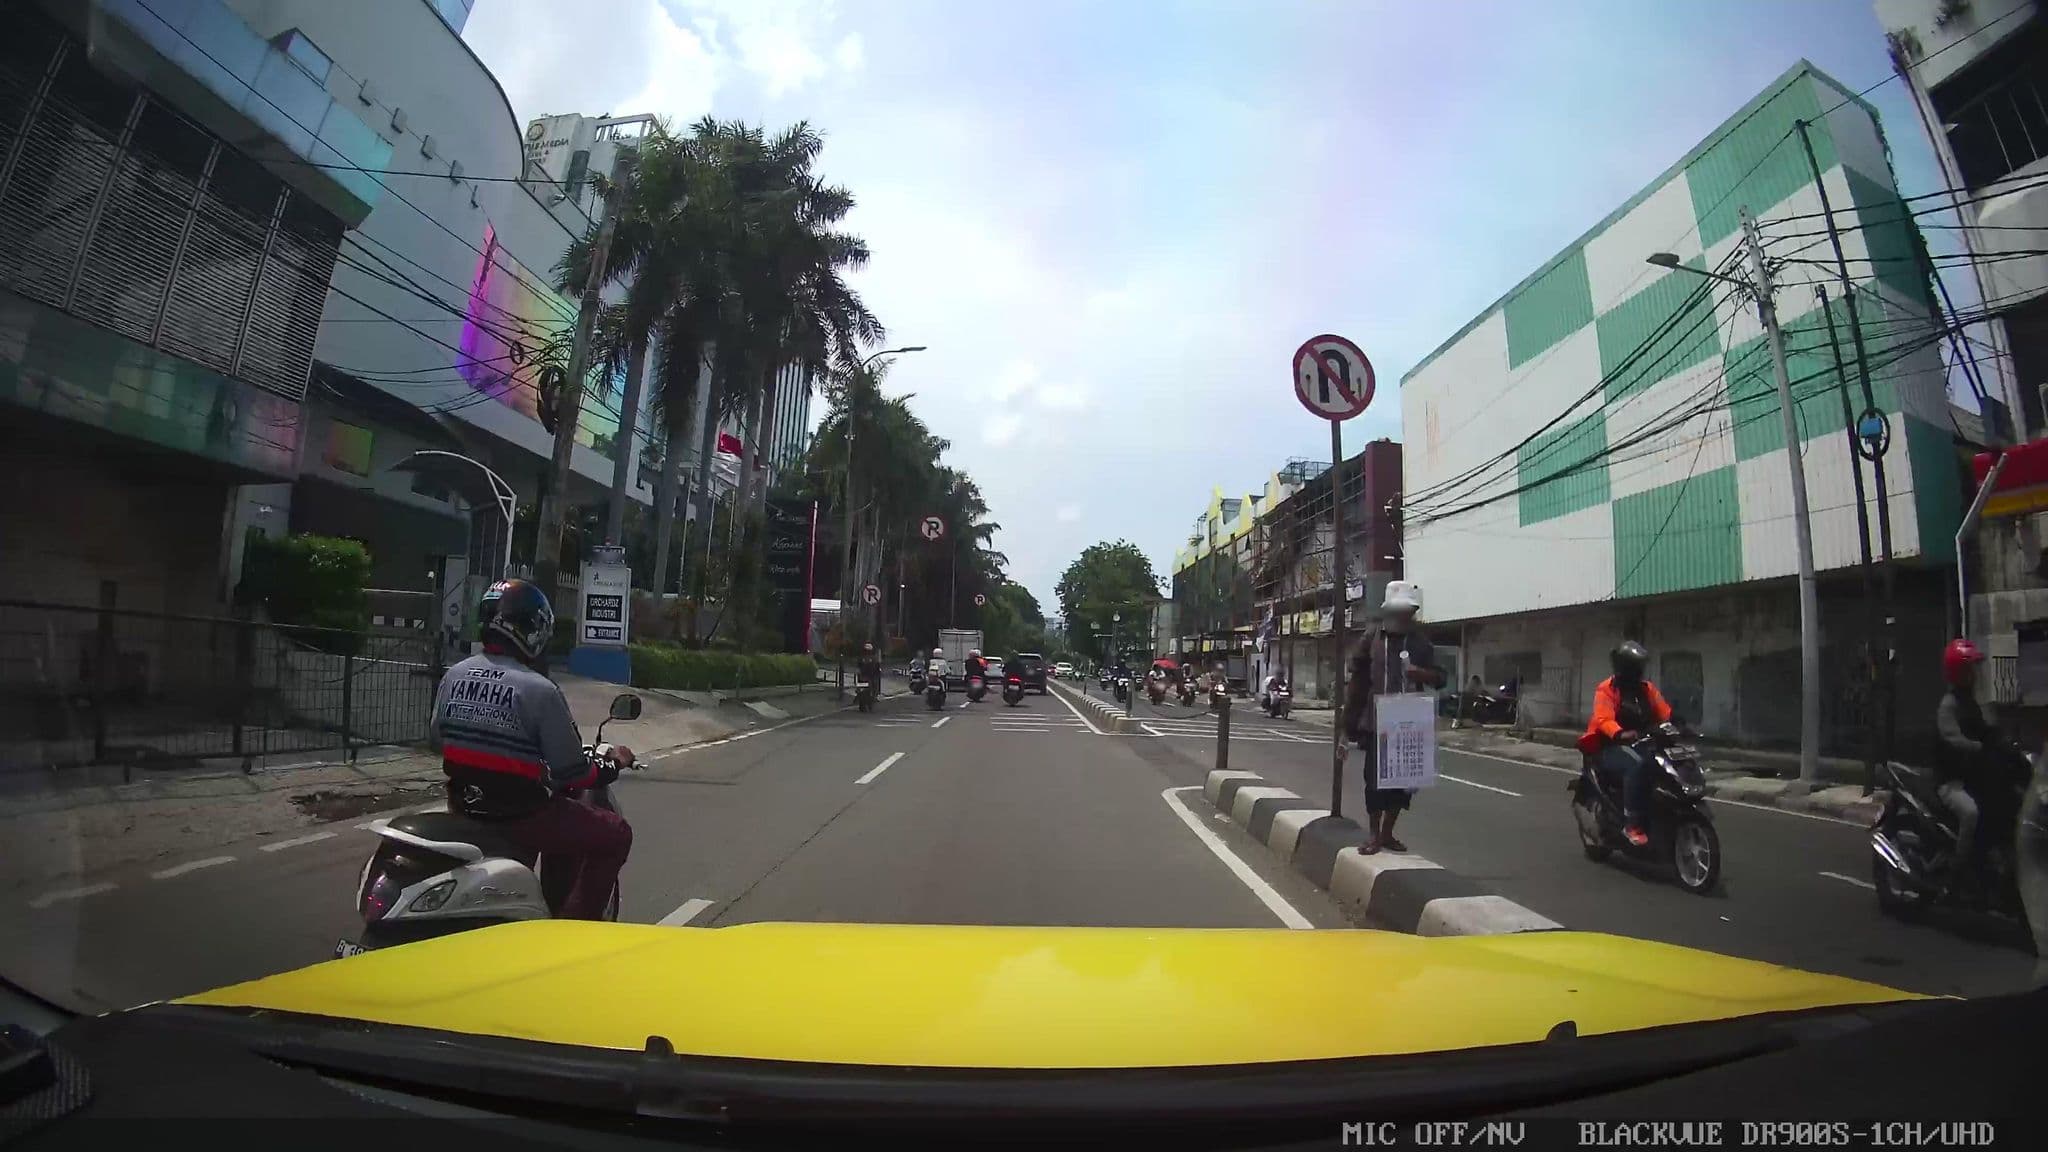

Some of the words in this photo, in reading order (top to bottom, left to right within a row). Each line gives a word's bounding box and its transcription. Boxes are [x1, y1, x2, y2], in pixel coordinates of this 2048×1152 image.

[467, 667, 505, 680] TEAM
[450, 680, 515, 709] YAMAHA
[447, 702, 519, 724] INTERNATIONAL
